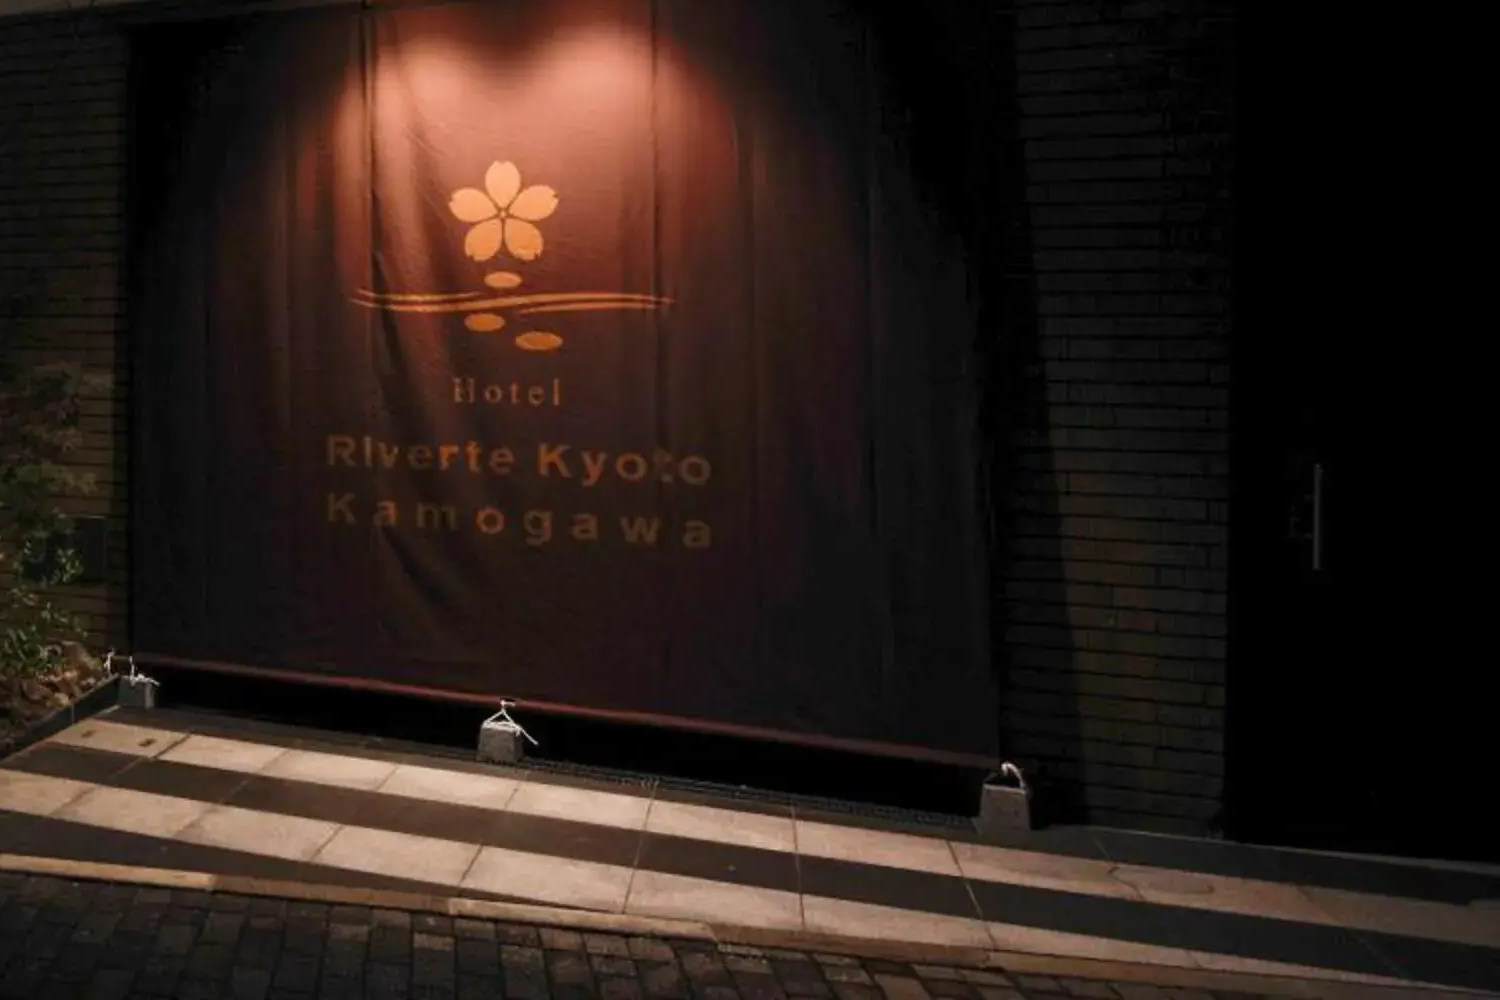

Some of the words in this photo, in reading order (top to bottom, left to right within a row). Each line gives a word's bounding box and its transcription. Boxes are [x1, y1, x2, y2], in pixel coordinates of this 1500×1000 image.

[452, 376, 561, 406] Hotel
[326, 435, 515, 474] Riverte
[537, 441, 712, 487] Kyoto
[326, 492, 712, 548] Kamogawa
